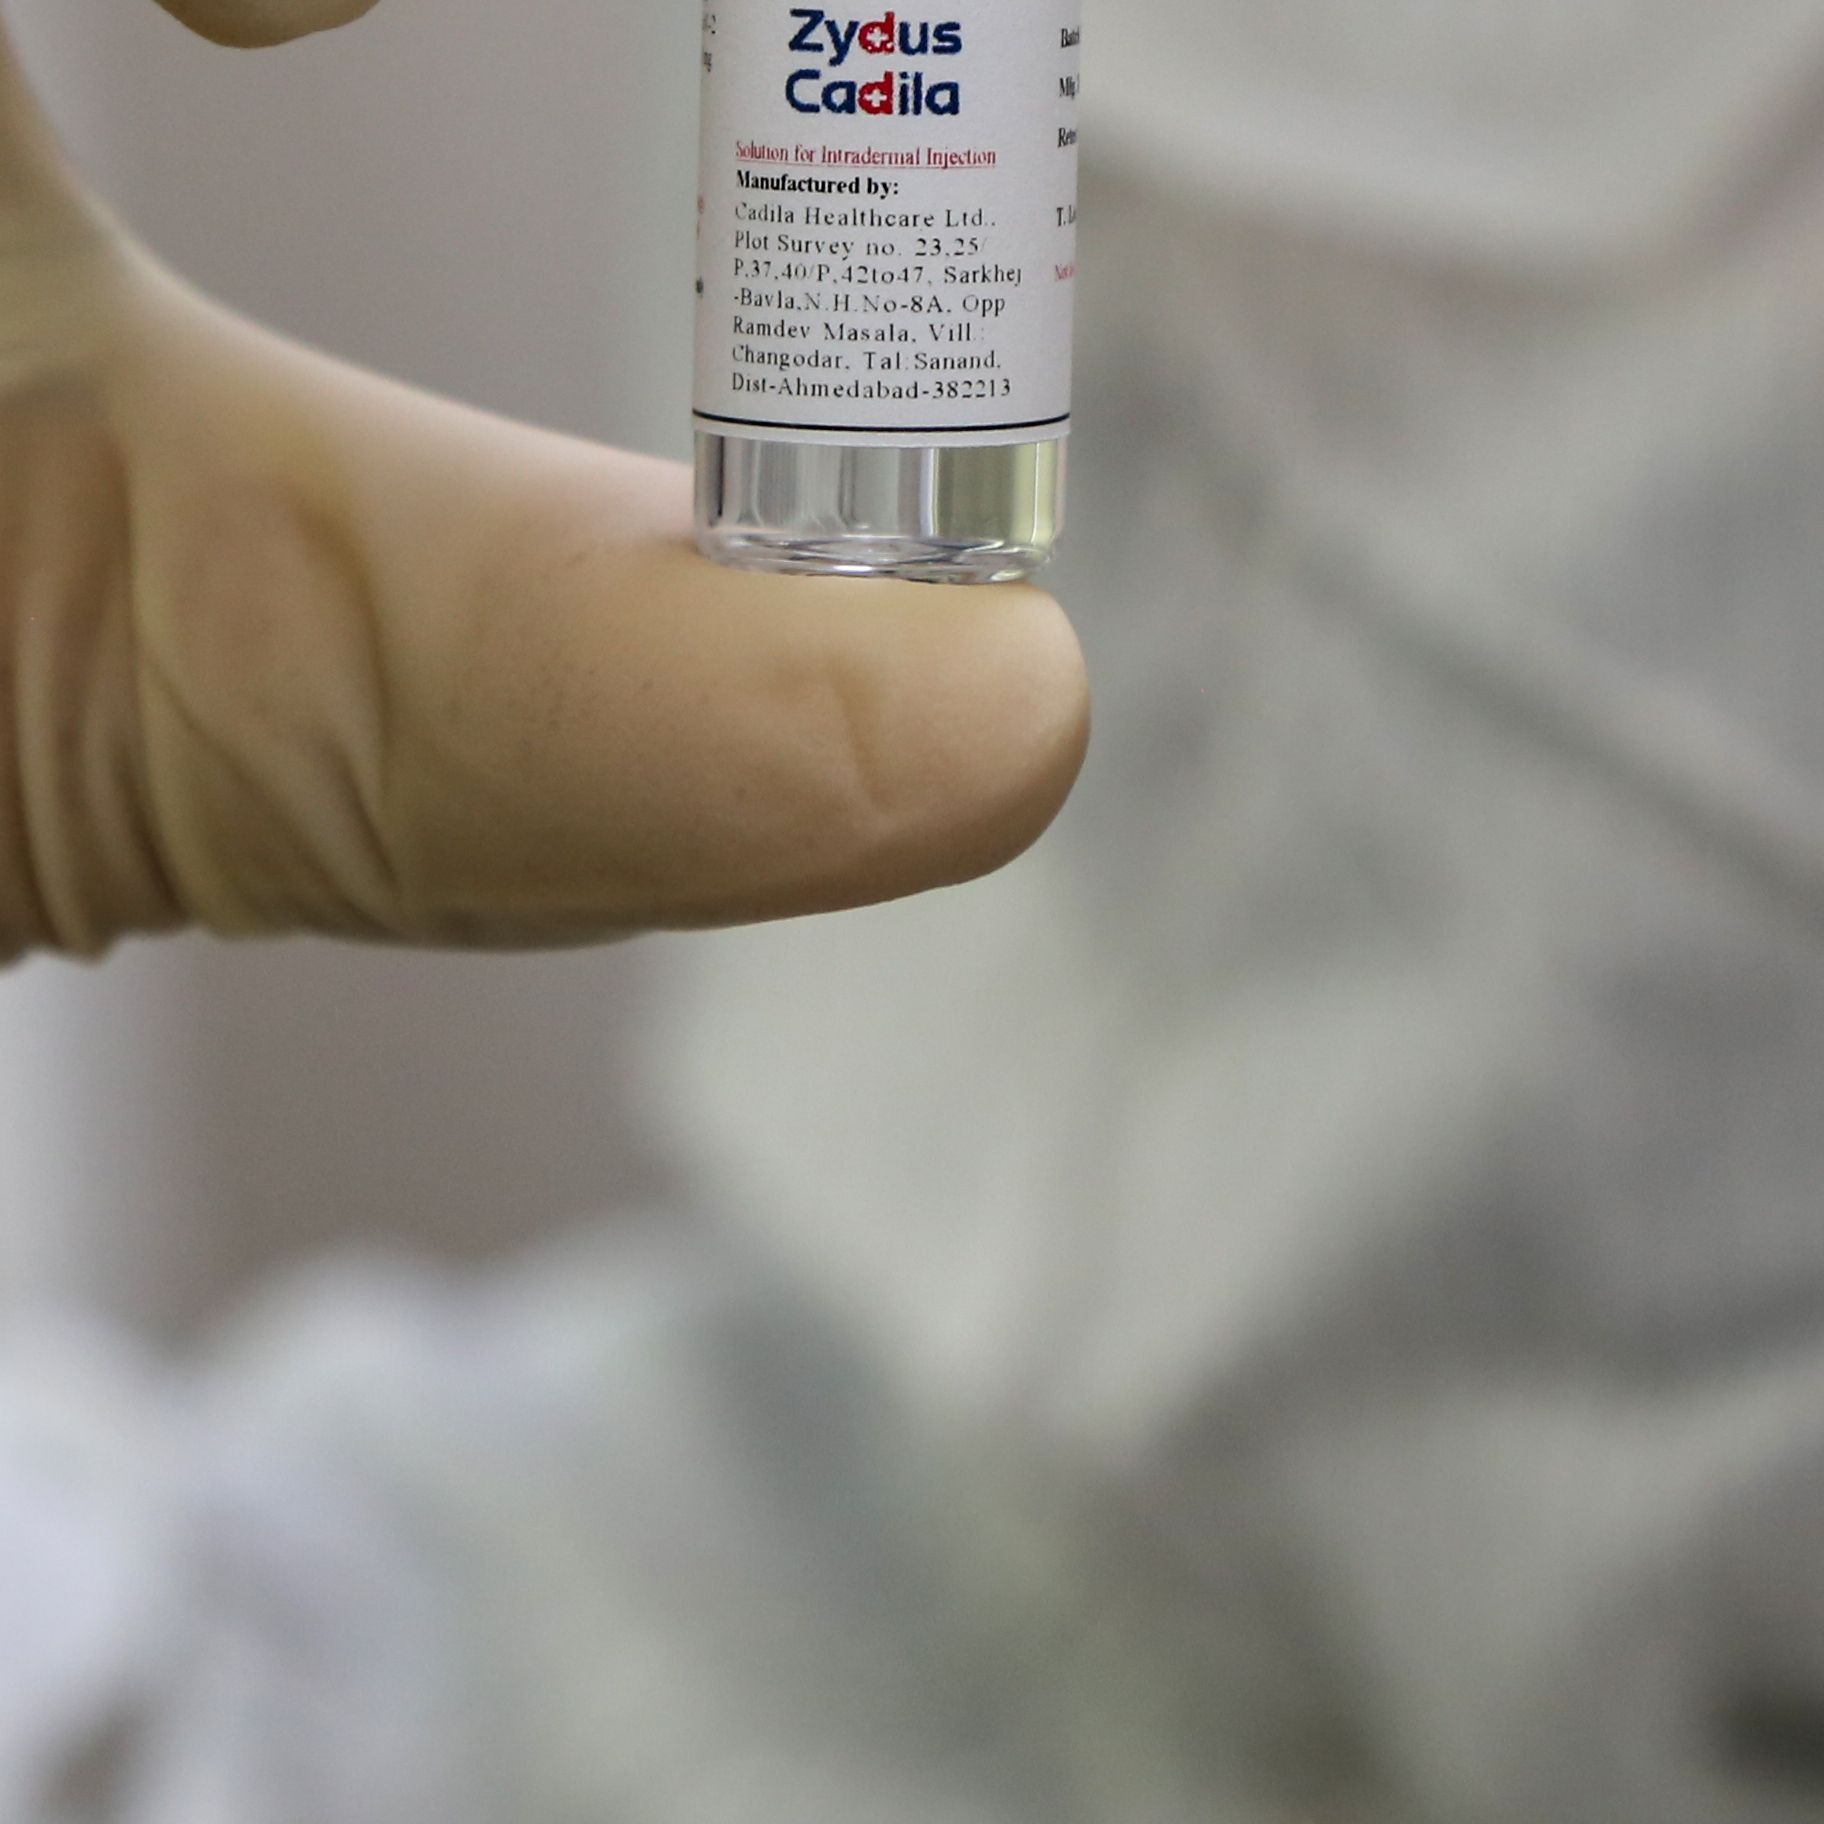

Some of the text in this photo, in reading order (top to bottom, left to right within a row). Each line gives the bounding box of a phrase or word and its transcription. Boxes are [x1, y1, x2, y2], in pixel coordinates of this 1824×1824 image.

[787, 8, 963, 67] Zydus
[785, 69, 960, 116] Cadila
[735, 139, 996, 170] Solution for Intradermal Injection
[735, 169, 899, 200] Manufactured by:
[734, 201, 794, 223] Cadila
[805, 206, 935, 227] Healthcare
[734, 230, 768, 251] Plot
[778, 234, 854, 261] Survey
[866, 242, 901, 256] no.
[944, 264, 1021, 288] Sarkhej
[962, 294, 1005, 318] Opp
[731, 314, 810, 339] Ramdev
[730, 371, 1010, 401] Dist-Ahmedabad-382213
